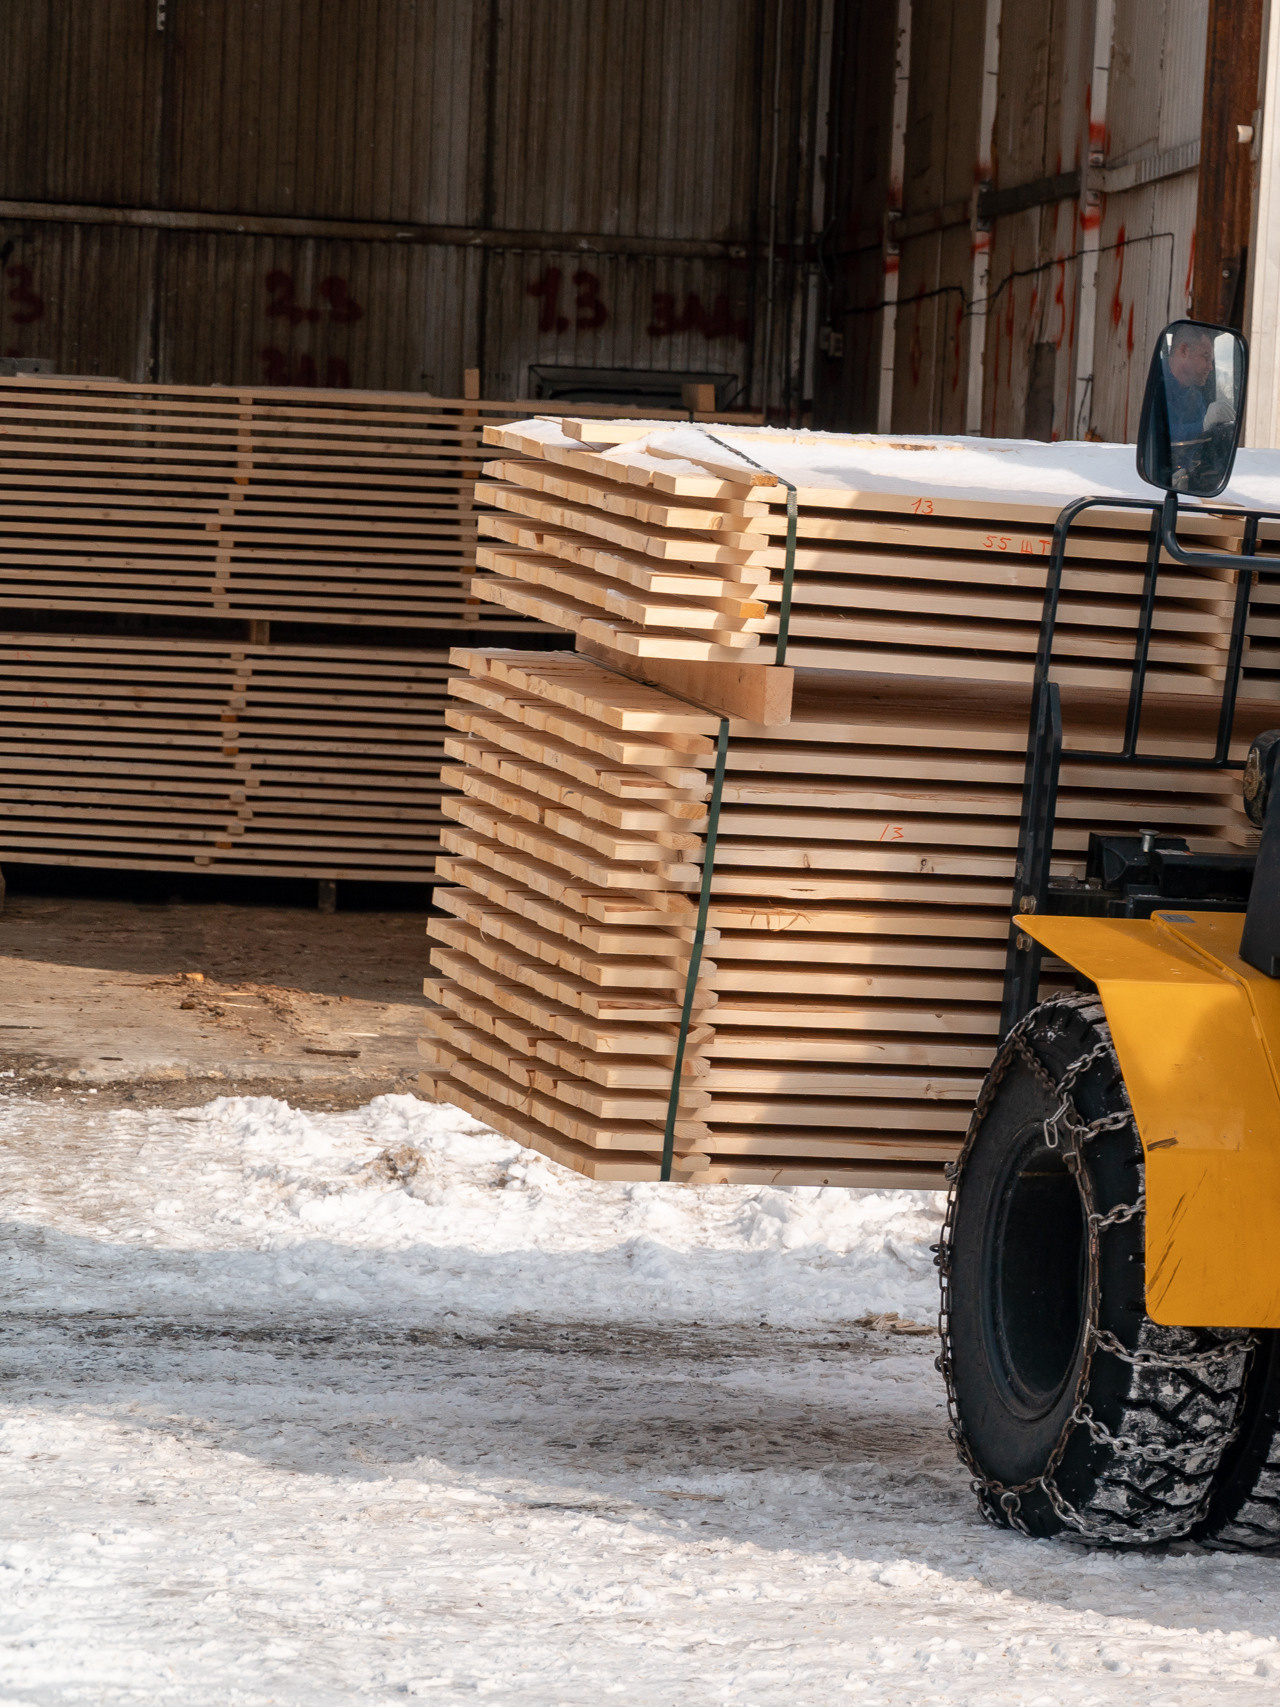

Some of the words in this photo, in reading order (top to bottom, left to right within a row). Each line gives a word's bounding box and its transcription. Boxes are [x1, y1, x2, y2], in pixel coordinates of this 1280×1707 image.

[527, 267, 607, 333] 1.3
[911, 498, 934, 515] 13
[982, 535, 1012, 551] 55
[879, 824, 905, 841] 13
